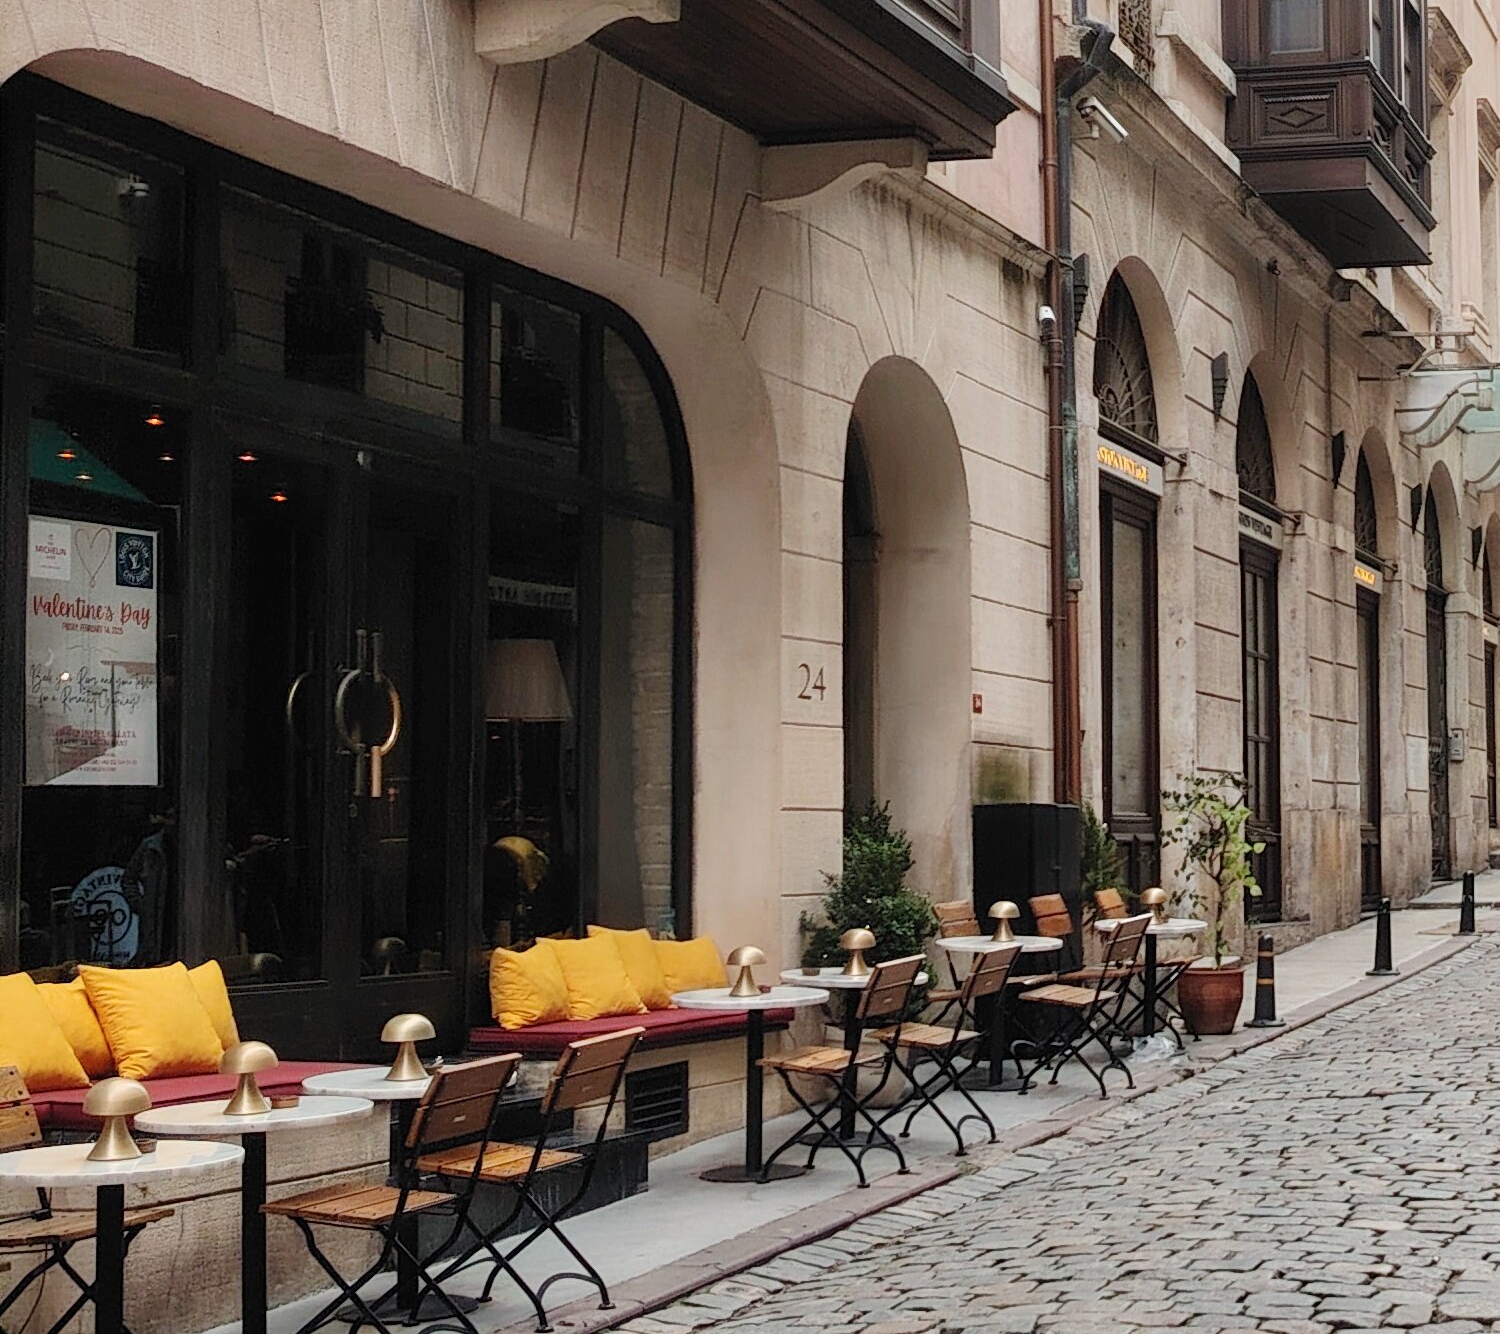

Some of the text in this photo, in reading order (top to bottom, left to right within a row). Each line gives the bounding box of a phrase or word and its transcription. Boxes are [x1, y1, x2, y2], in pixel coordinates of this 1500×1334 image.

[33, 593, 151, 629] Valentine's Day
[797, 663, 826, 701] 24
